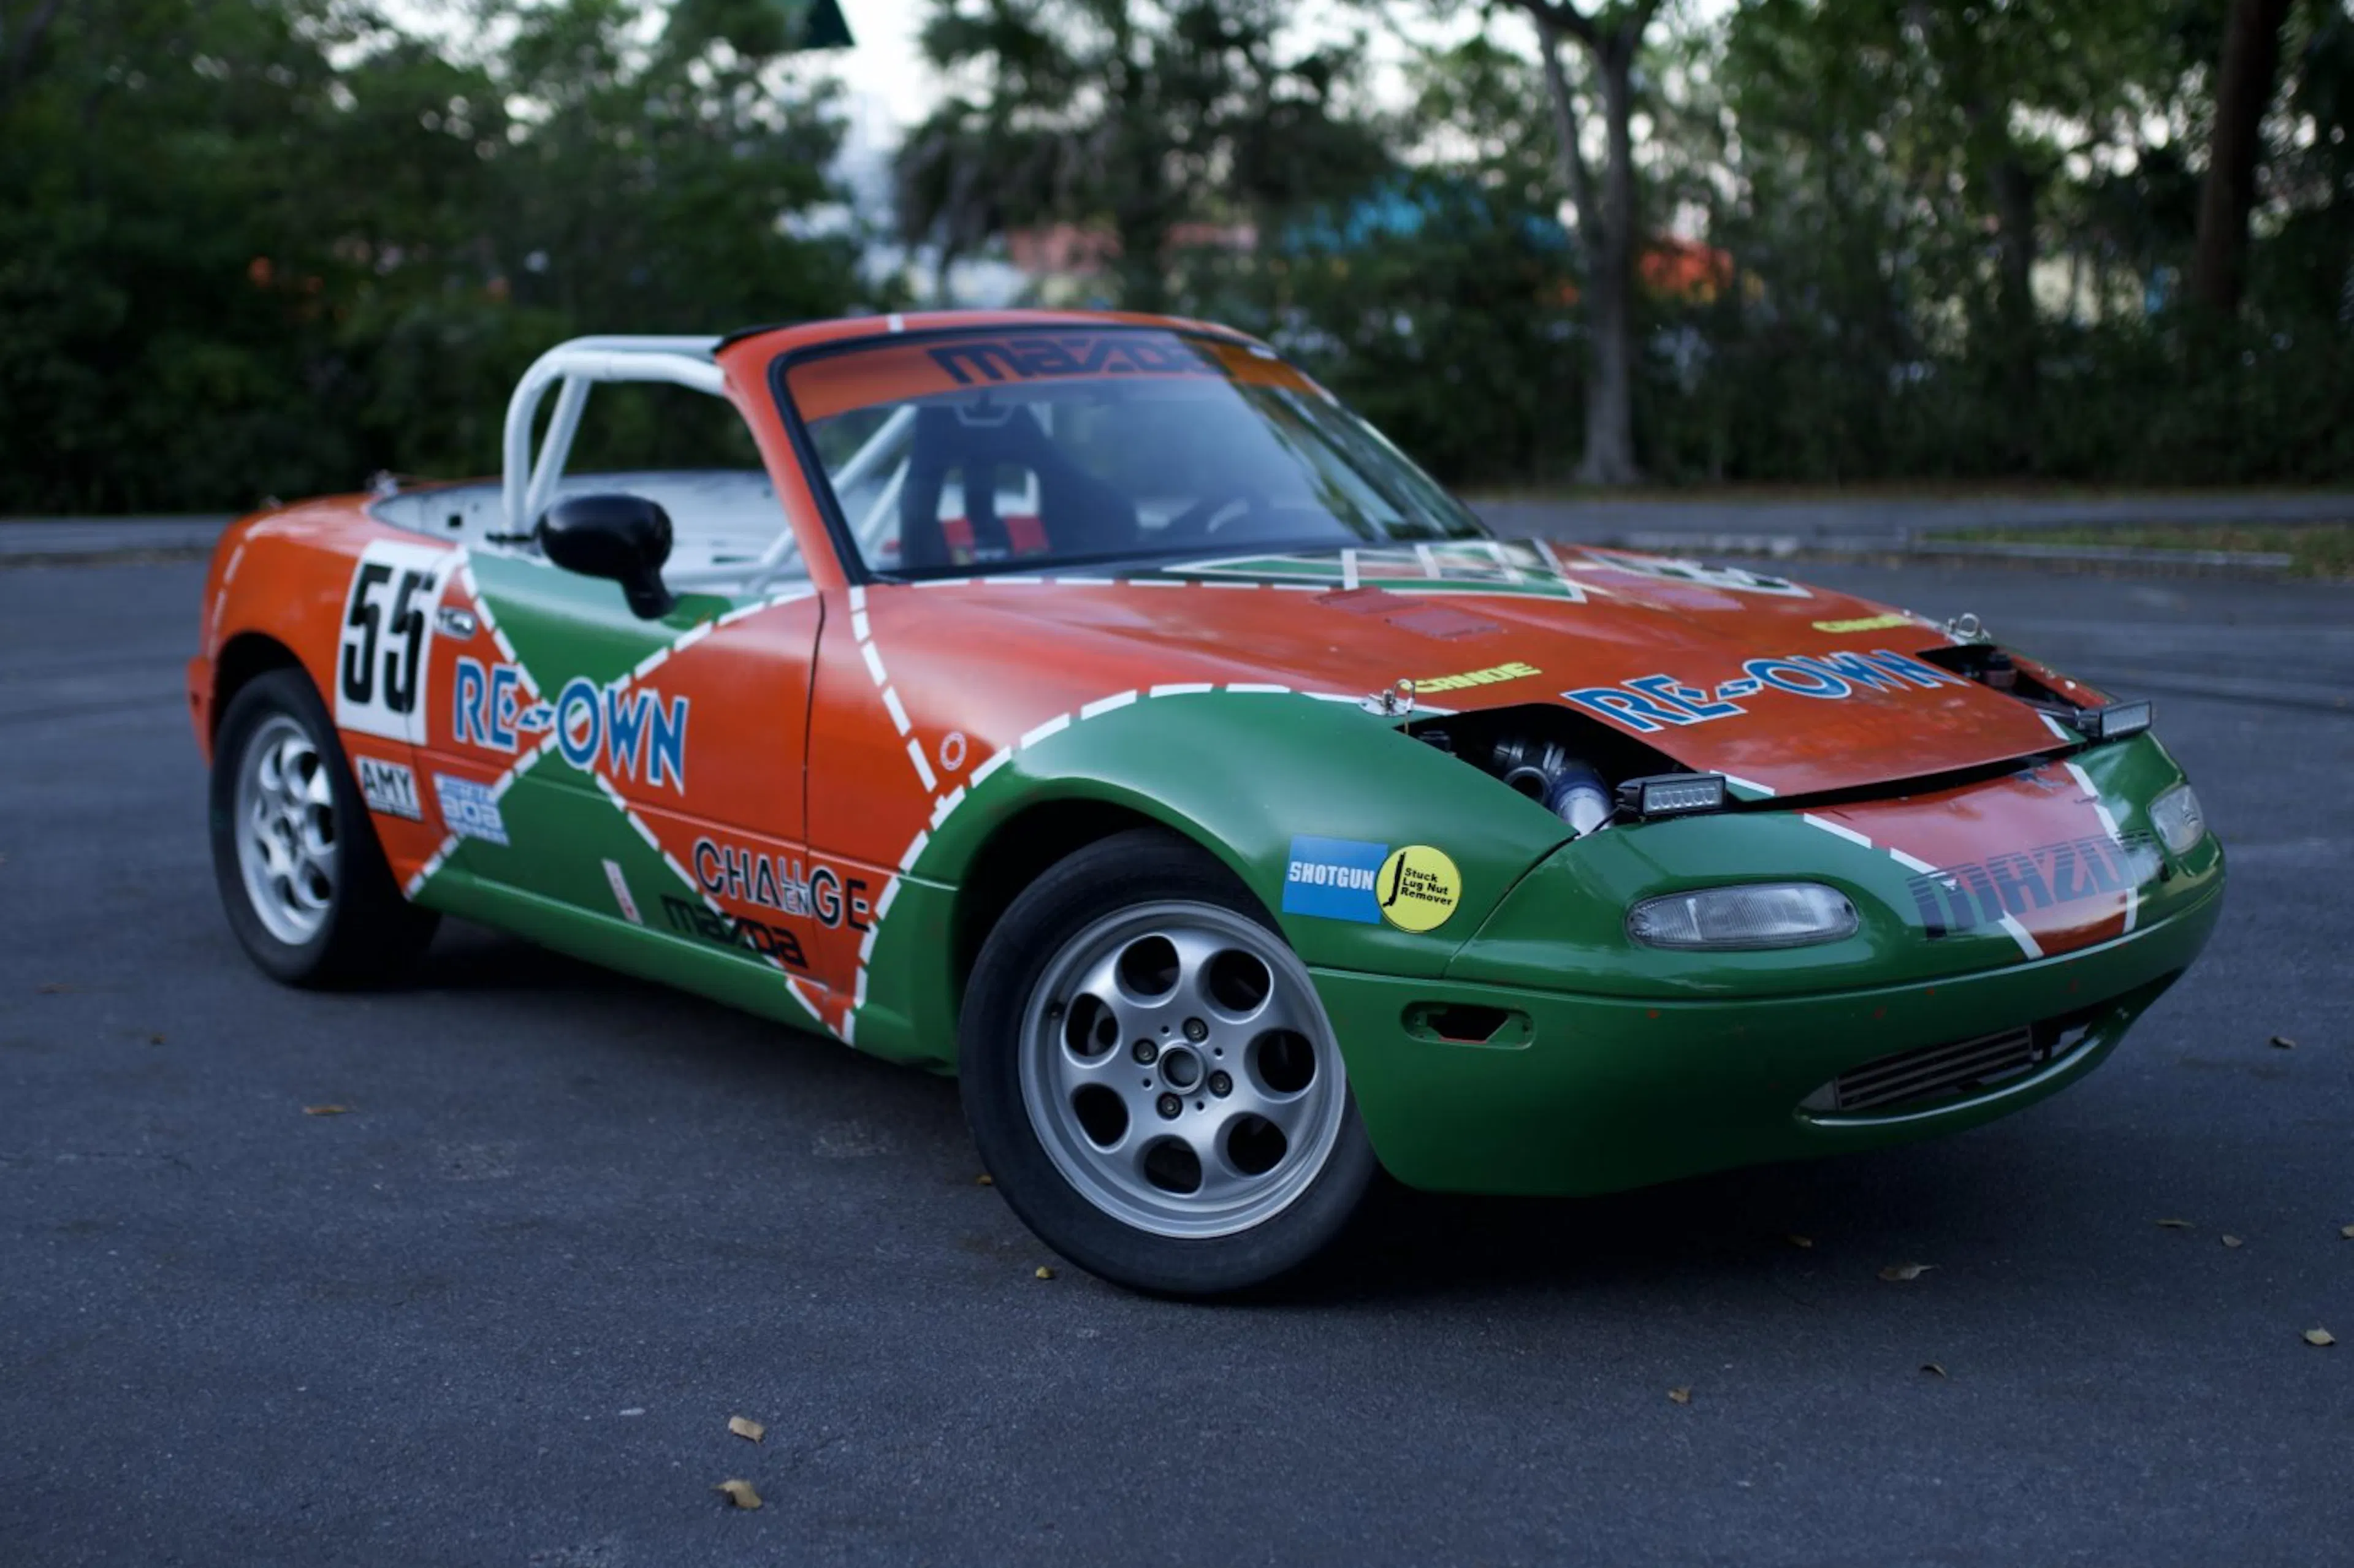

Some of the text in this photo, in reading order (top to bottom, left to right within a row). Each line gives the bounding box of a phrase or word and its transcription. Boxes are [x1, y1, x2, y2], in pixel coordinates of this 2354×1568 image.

[341, 563, 435, 715] 55
[363, 762, 412, 807] AMY
[1289, 861, 1375, 891] SHOTGUN
[1403, 877, 1448, 895] Lug Nut
[1404, 868, 1438, 883] Stuck
[1400, 887, 1452, 905] Remover
